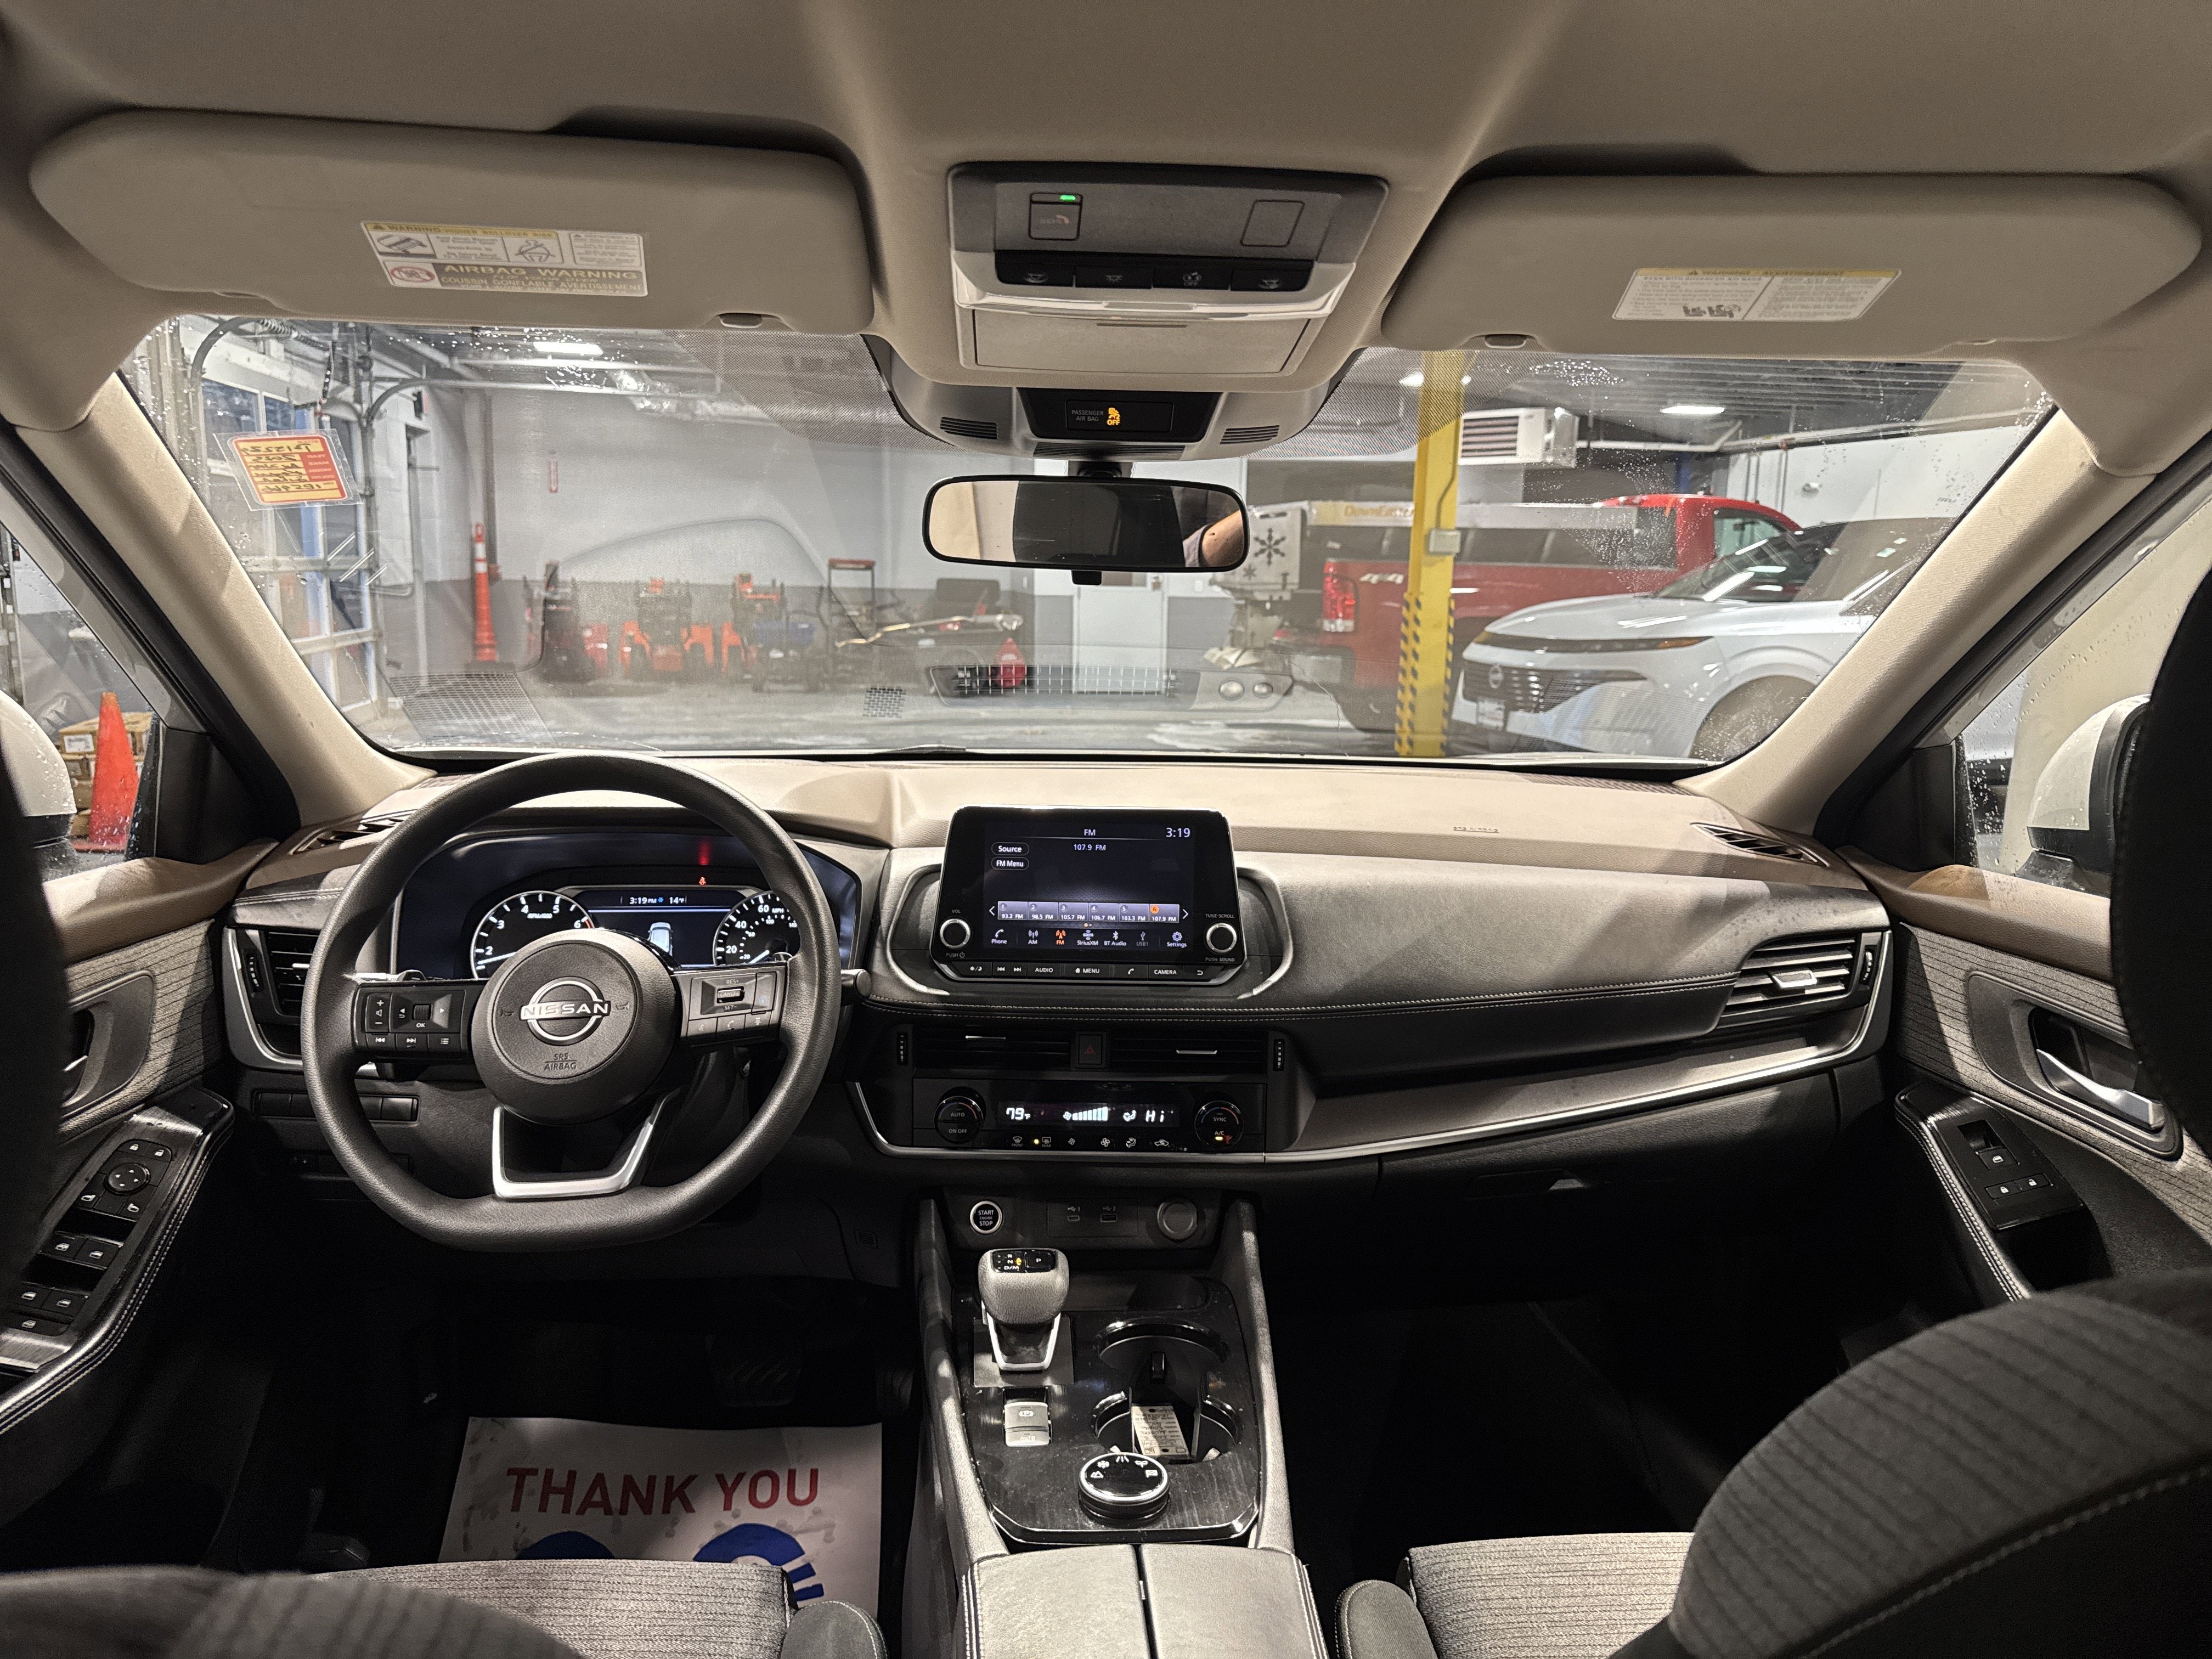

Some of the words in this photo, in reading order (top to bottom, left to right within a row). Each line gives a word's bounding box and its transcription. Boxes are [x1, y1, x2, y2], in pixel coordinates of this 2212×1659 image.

[445, 265, 527, 275] AIRBAG
[537, 268, 637, 280] WARNING
[441, 276, 488, 286] COUSSIN
[493, 279, 555, 288] GONFLABLE
[560, 281, 641, 291] AVERTISSEMENT
[1166, 827, 1190, 838] 3:19
[521, 905, 529, 913] 4
[552, 905, 560, 914] 5
[758, 905, 770, 913] 60
[496, 920, 505, 929] 3
[574, 919, 582, 928] 6
[735, 921, 747, 929] 40
[486, 946, 493, 955] 2
[725, 945, 737, 953] 20
[523, 1003, 608, 1017] NISSAN
[554, 1053, 569, 1061] SRS
[544, 1062, 577, 1071] AIRBAG
[506, 1467, 698, 1516] THANK
[715, 1468, 820, 1512] YOU
